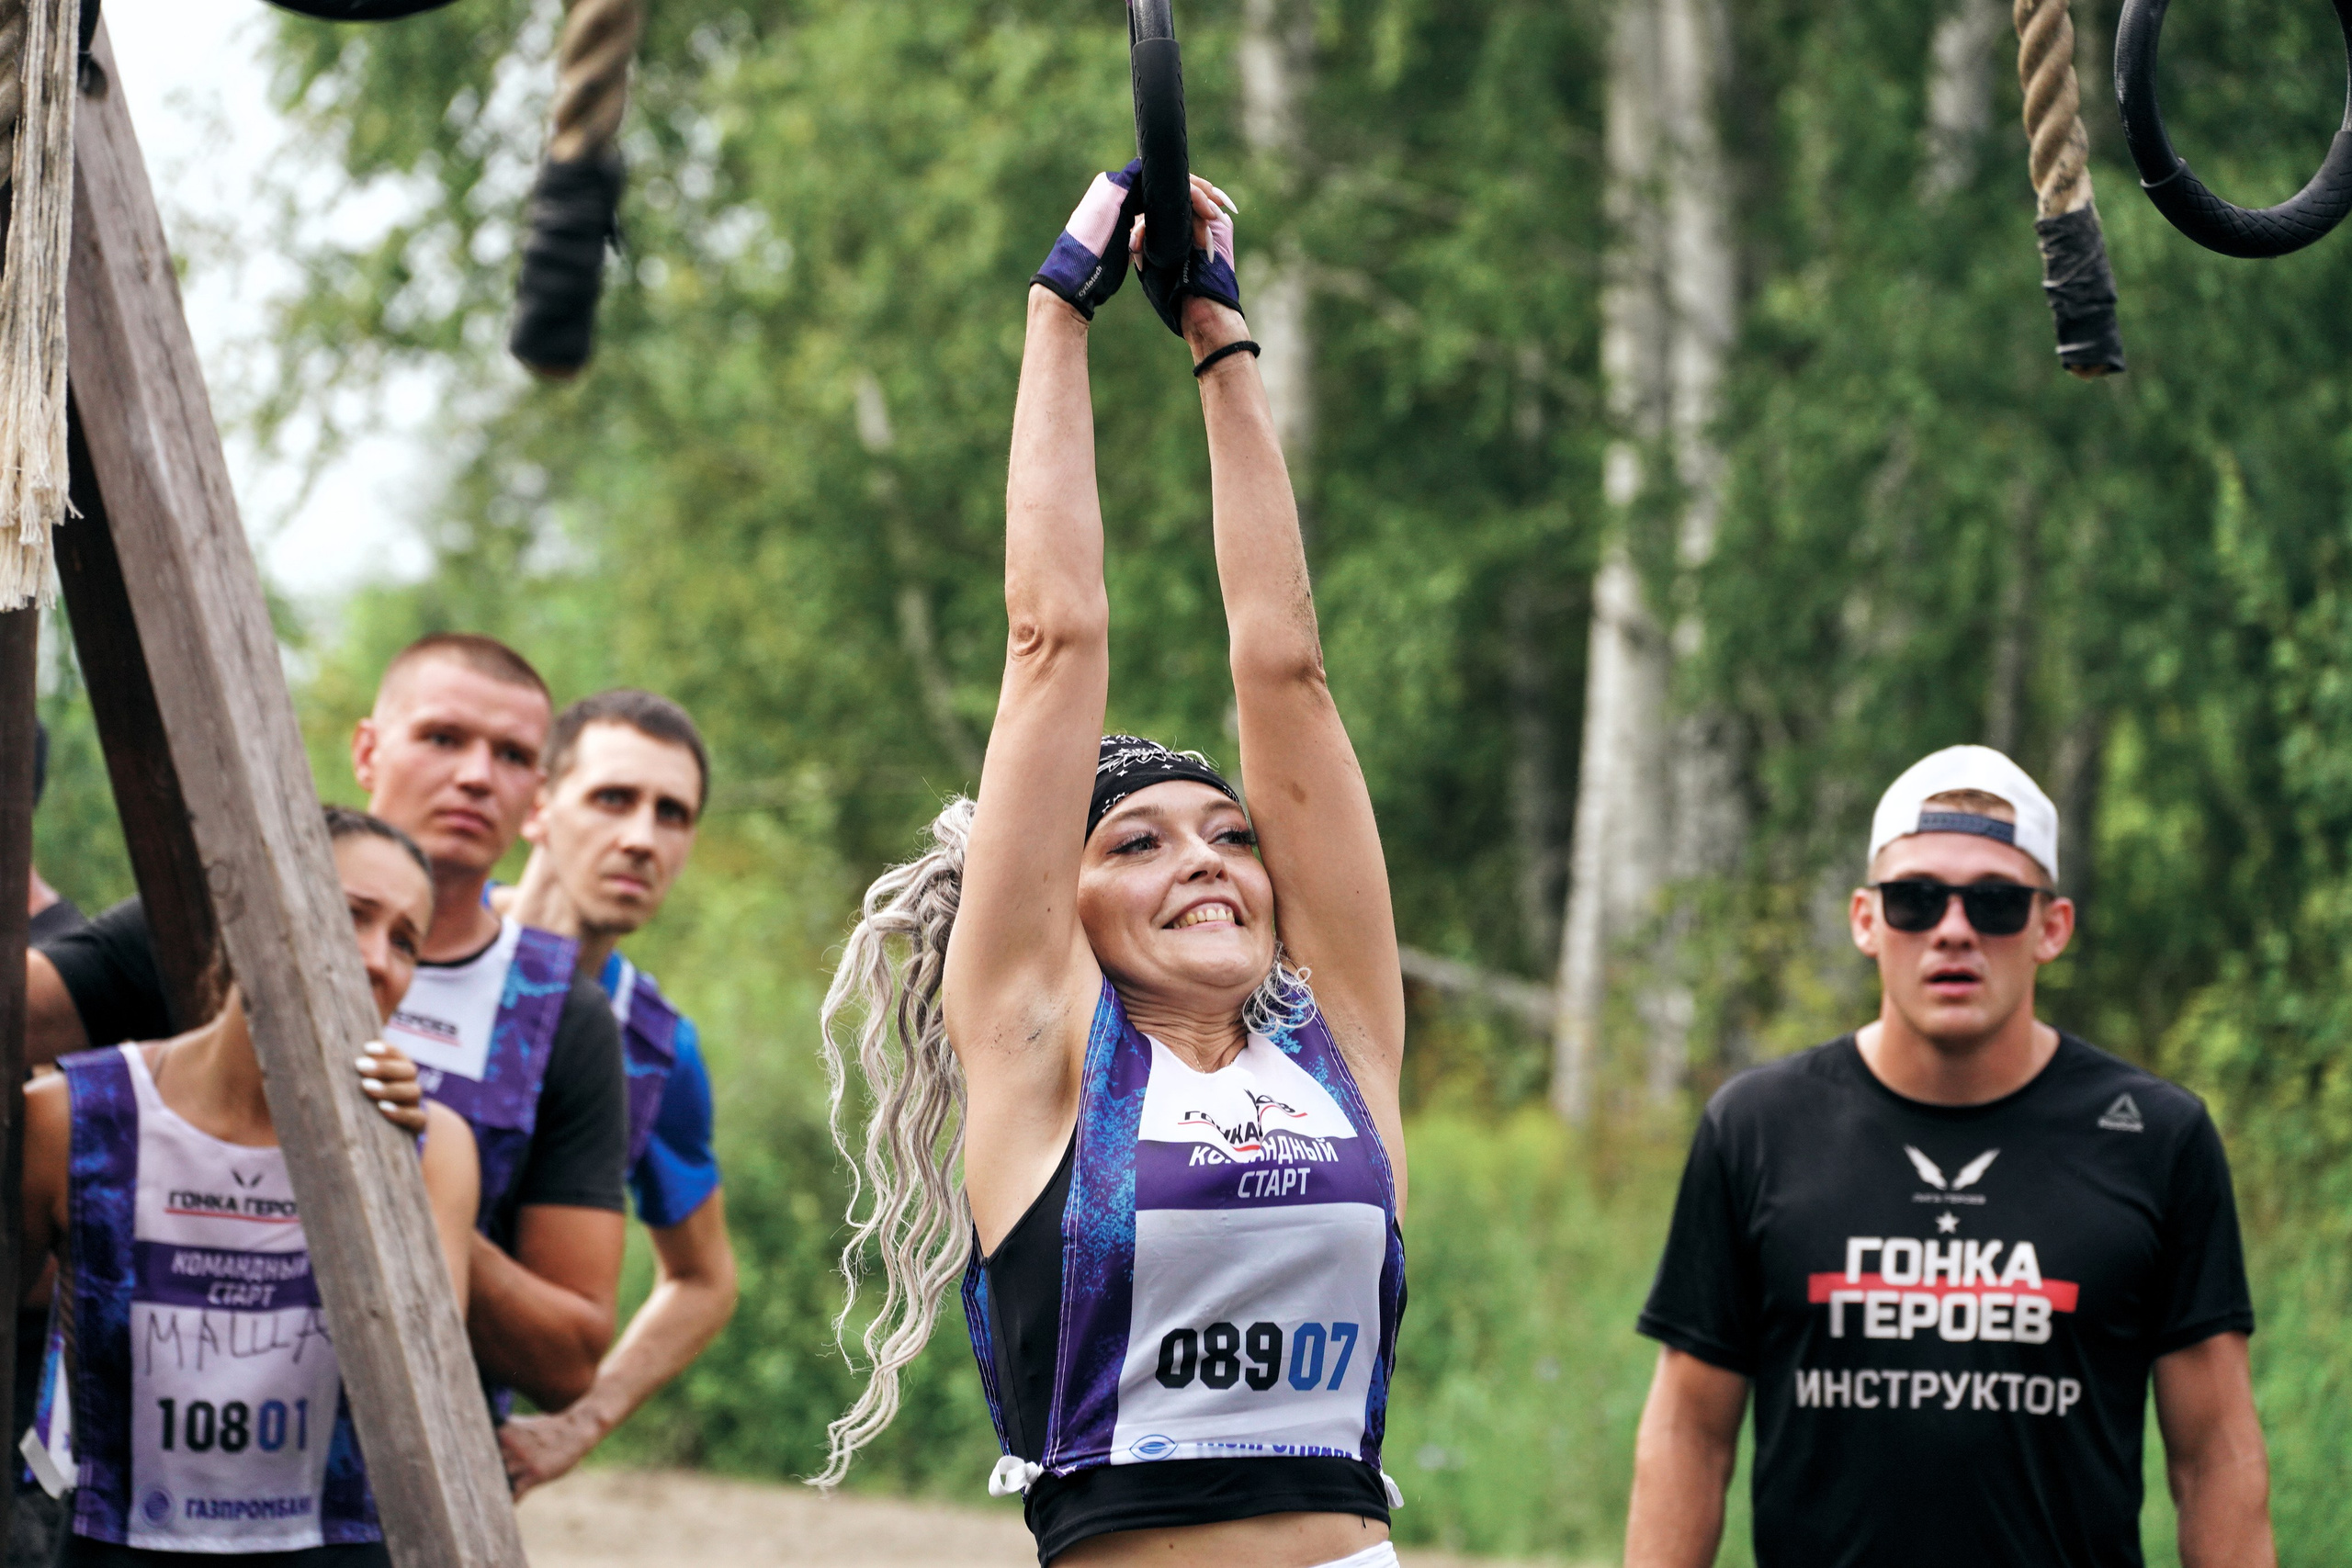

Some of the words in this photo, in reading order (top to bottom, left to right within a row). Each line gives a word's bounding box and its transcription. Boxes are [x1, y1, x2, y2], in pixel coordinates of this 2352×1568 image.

[169, 1191, 239, 1211] ГОНКА
[243, 1198, 297, 1217] ГЕРО
[1238, 1168, 1311, 1199] СТАРТ
[1845, 1236, 2043, 1290] ГОНКА
[207, 1281, 277, 1308] СТАРТ
[1828, 1289, 2053, 1345] ГЕРОЕВ
[1155, 1322, 1360, 1392] 08907
[1794, 1369, 2083, 1416] ИНСТРУКТОР
[158, 1397, 309, 1453] 10801
